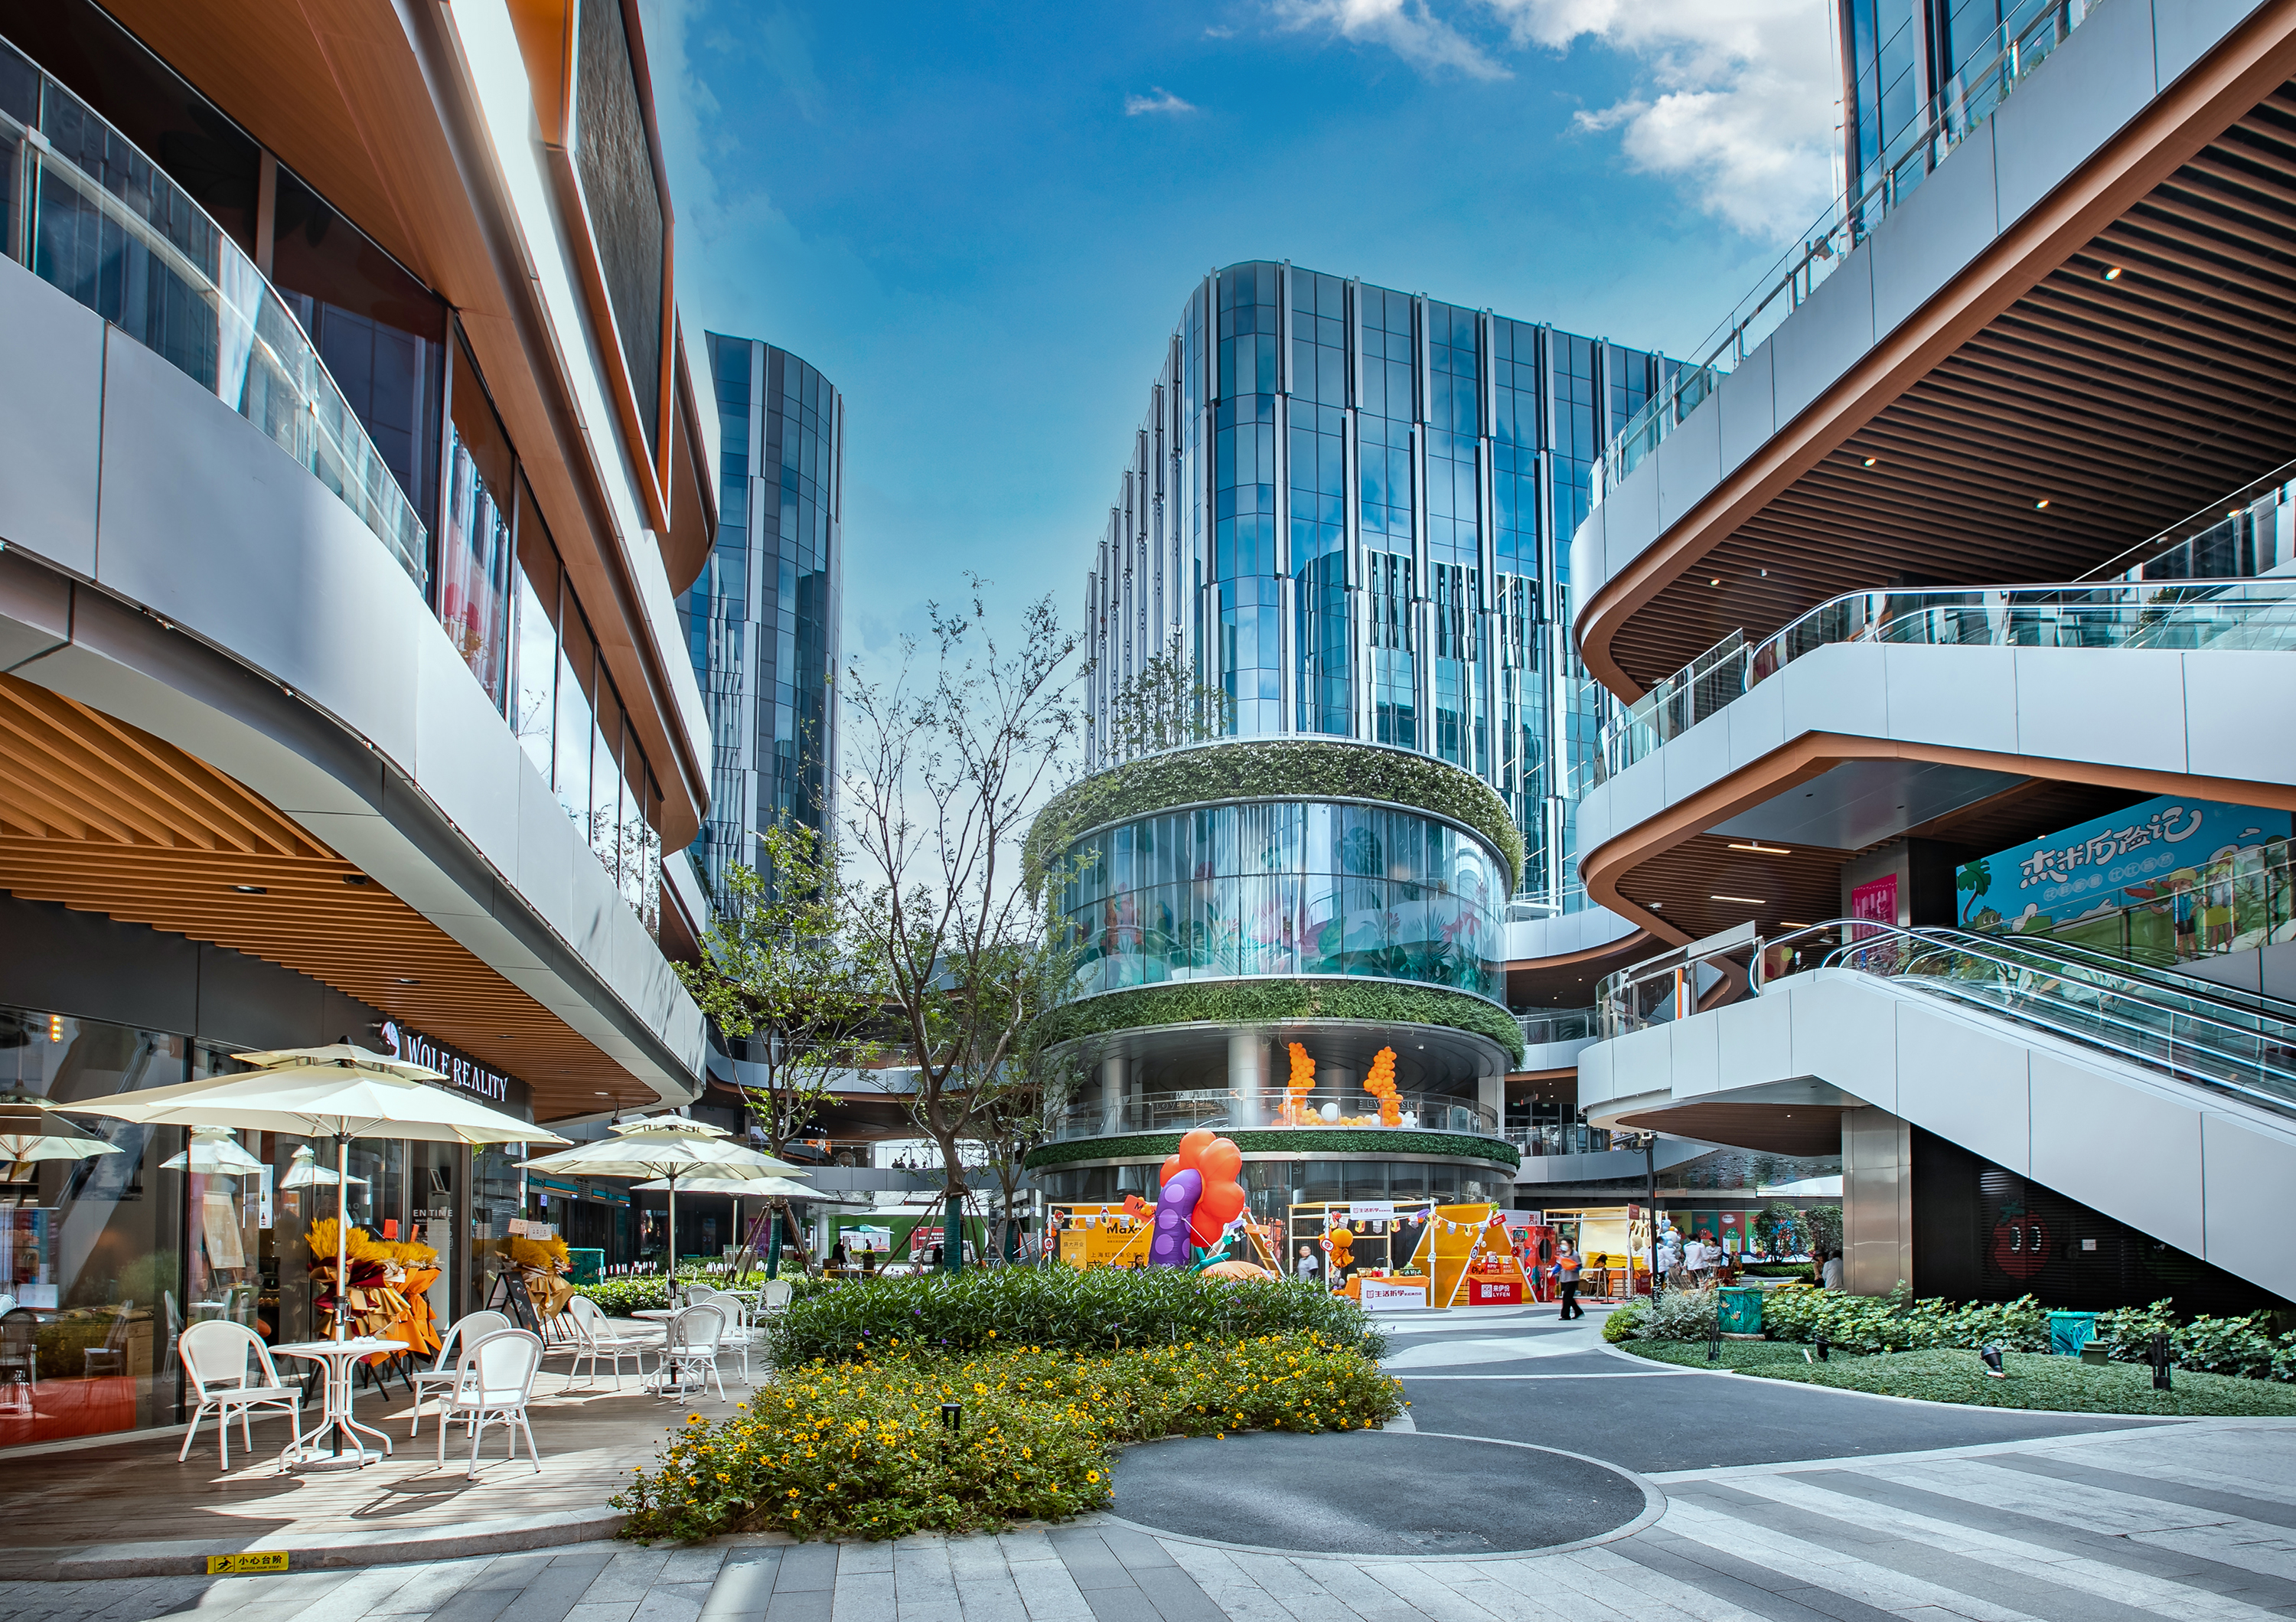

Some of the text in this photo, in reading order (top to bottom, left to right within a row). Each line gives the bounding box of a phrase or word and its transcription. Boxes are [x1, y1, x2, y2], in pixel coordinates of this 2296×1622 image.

[2020, 806, 2203, 889] 杰米历险记
[406, 1035, 450, 1075] WOLF
[453, 1057, 509, 1102] REALITY
[239, 1555, 282, 1565] 小心台阶
